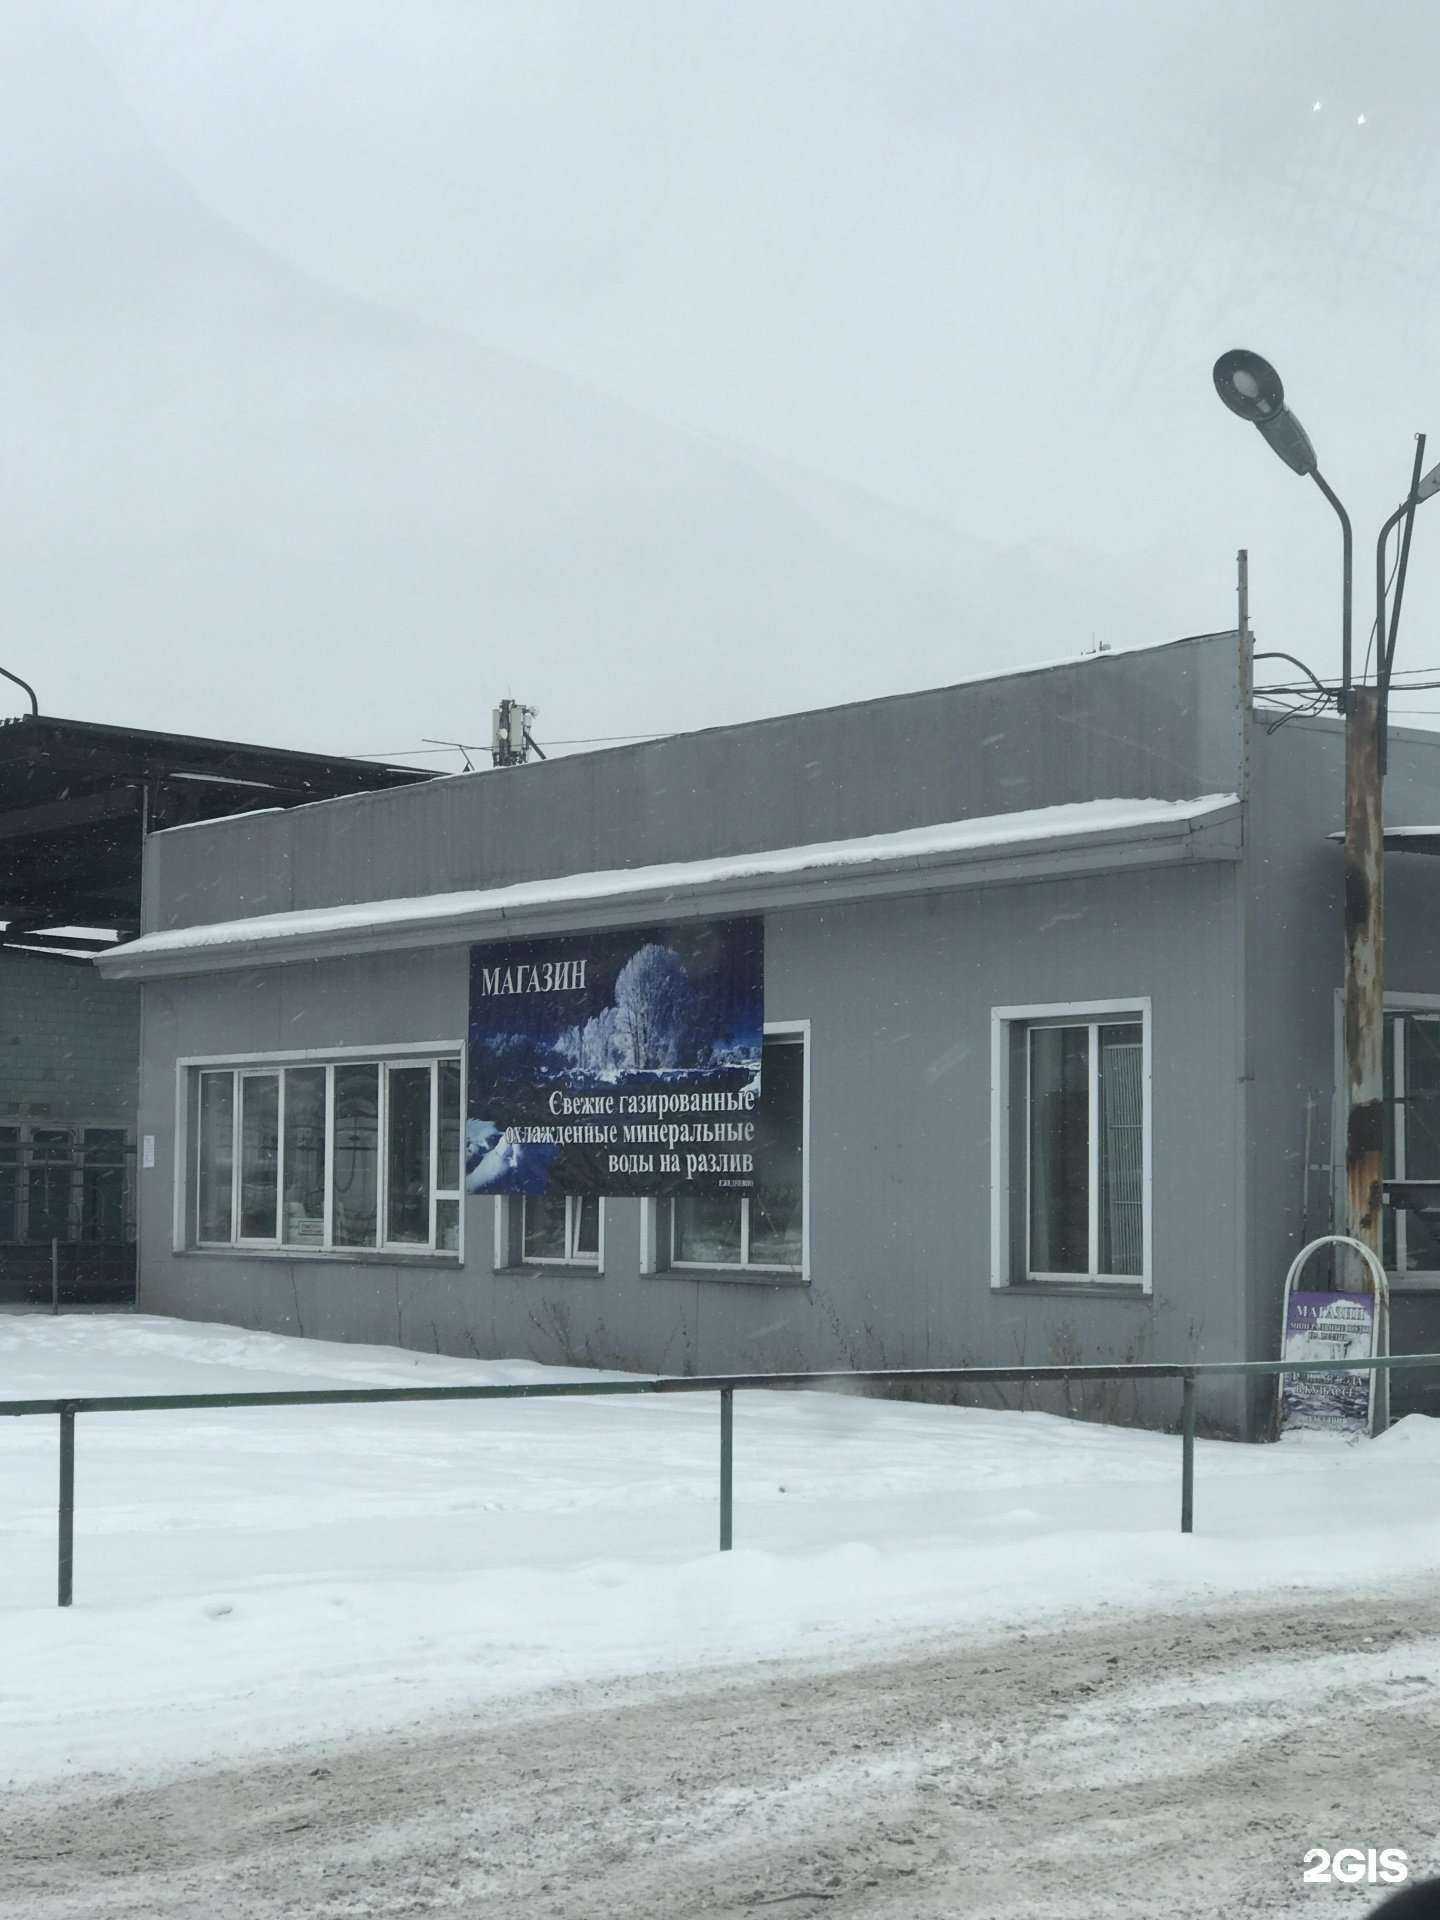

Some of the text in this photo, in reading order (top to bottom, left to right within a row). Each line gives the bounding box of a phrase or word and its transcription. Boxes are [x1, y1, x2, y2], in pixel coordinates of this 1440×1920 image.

[481, 960, 588, 997] МАГАЗИН
[548, 1089, 755, 1120] Свежие газированные
[505, 1121, 755, 1150] охлажденные минеральные
[608, 1152, 754, 1180] воды на разлив
